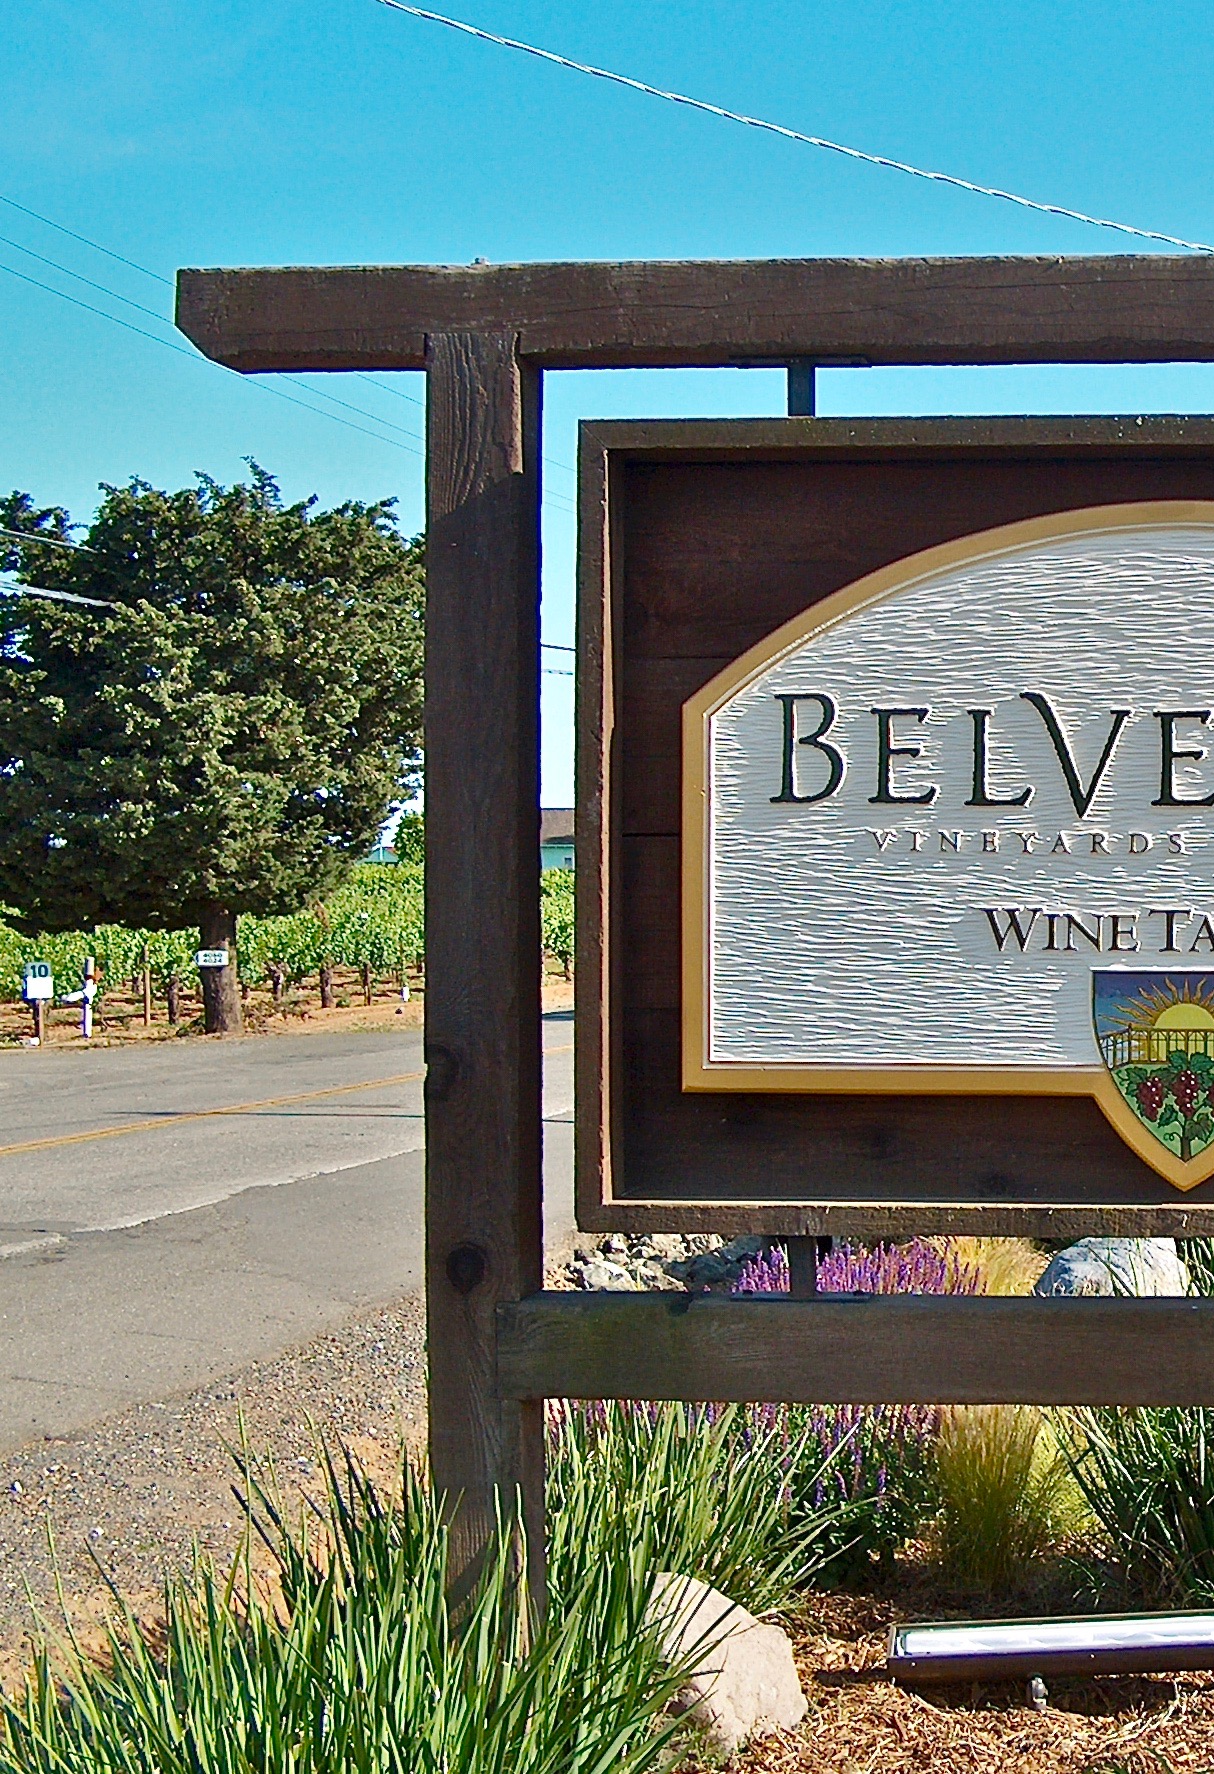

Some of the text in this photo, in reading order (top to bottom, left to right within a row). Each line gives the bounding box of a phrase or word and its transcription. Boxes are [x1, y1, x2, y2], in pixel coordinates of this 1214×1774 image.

[871, 830, 1186, 854] VINEYARDS
[984, 908, 1141, 953] WINE
[30, 964, 49, 979] 10
